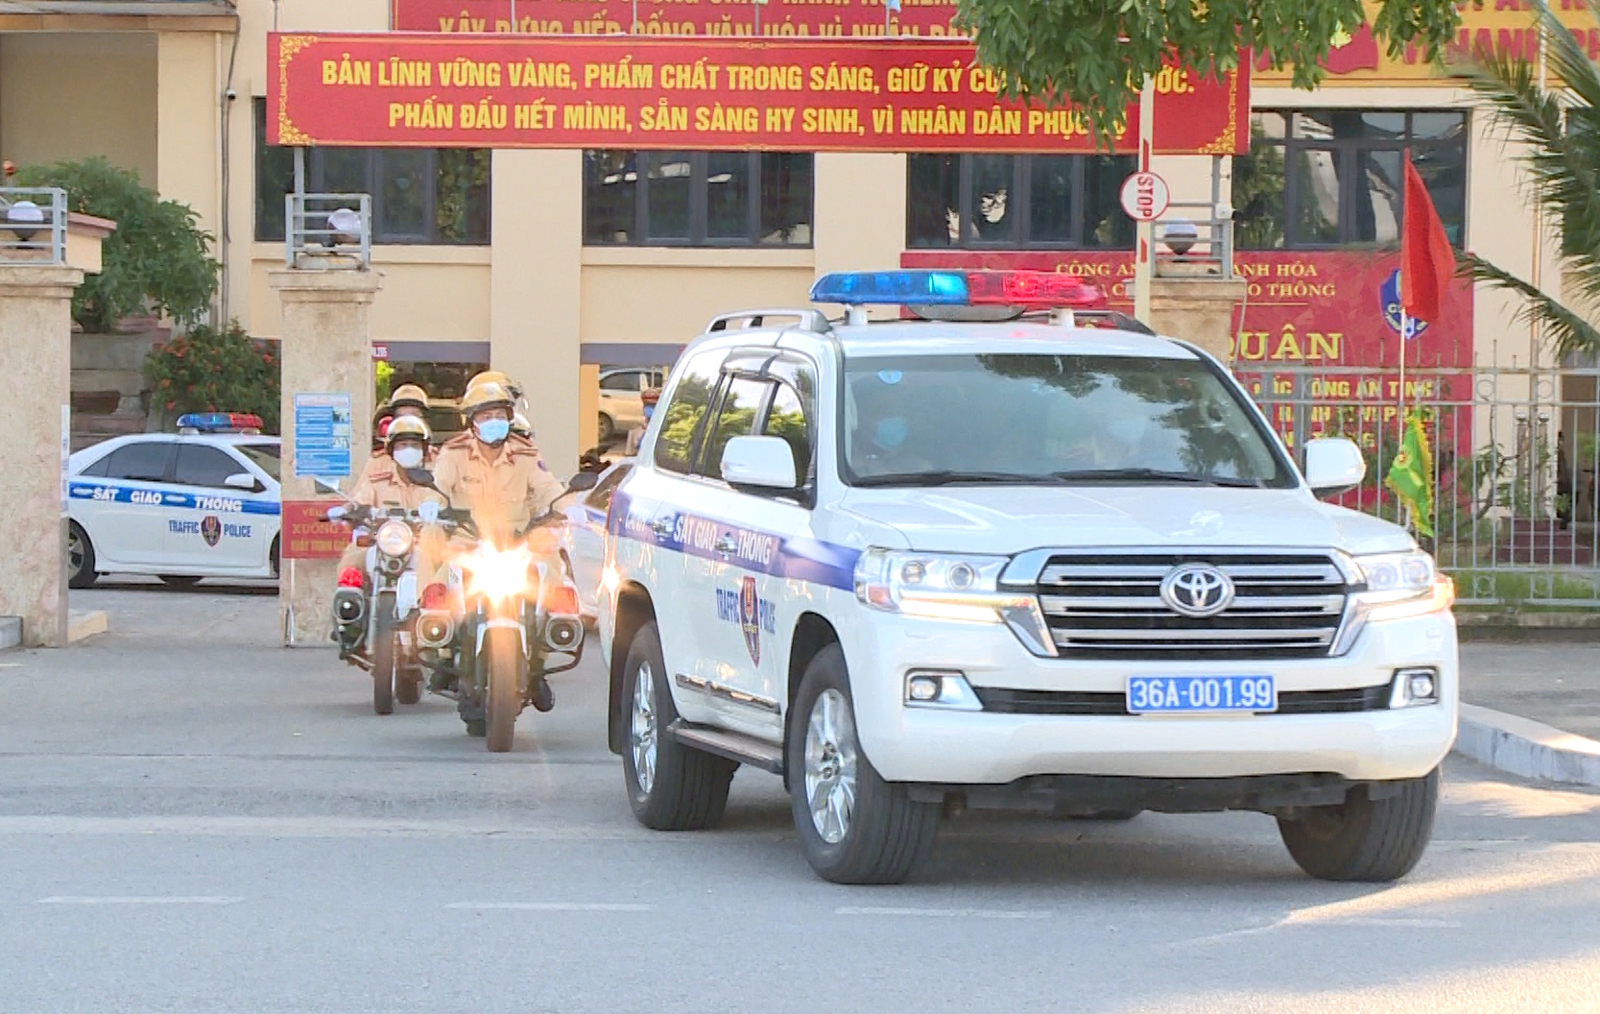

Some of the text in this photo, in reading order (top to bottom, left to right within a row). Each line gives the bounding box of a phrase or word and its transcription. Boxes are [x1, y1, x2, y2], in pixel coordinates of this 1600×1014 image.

[321, 53, 371, 86] BẢN
[378, 56, 431, 87] LĨNH
[438, 57, 501, 88] VỮNG
[508, 57, 578, 91] VÀNG,
[584, 55, 653, 90] PHẨM
[660, 56, 721, 91] CHẤT
[726, 64, 802, 92] TRONG
[809, 60, 880, 95] SÁNG,
[887, 61, 930, 93] GIỮ
[932, 59, 963, 93] KỶ
[388, 94, 453, 128] PHẤN
[460, 95, 507, 130] ĐẤU
[514, 97, 556, 130] HẾT
[563, 101, 632, 134] MÌNH,
[640, 97, 688, 132] SẴN
[694, 102, 758, 133] SÀNG
[765, 107, 796, 133] HY
[802, 107, 865, 137] SINH,
[871, 104, 894, 134] VÌ
[901, 105, 966, 135] NHÂN
[973, 105, 1022, 135] DÂN
[1136, 176, 1154, 217] STOP
[1055, 259, 1111, 276] CÔNG
[1276, 260, 1318, 277] HÓA
[1266, 279, 1336, 297] THÔNG
[1229, 323, 1344, 361] UÂN
[130, 490, 163, 505] GIAO
[168, 519, 252, 538] TRAFFIC POLICE
[1131, 678, 1272, 708] 36A-001.99
